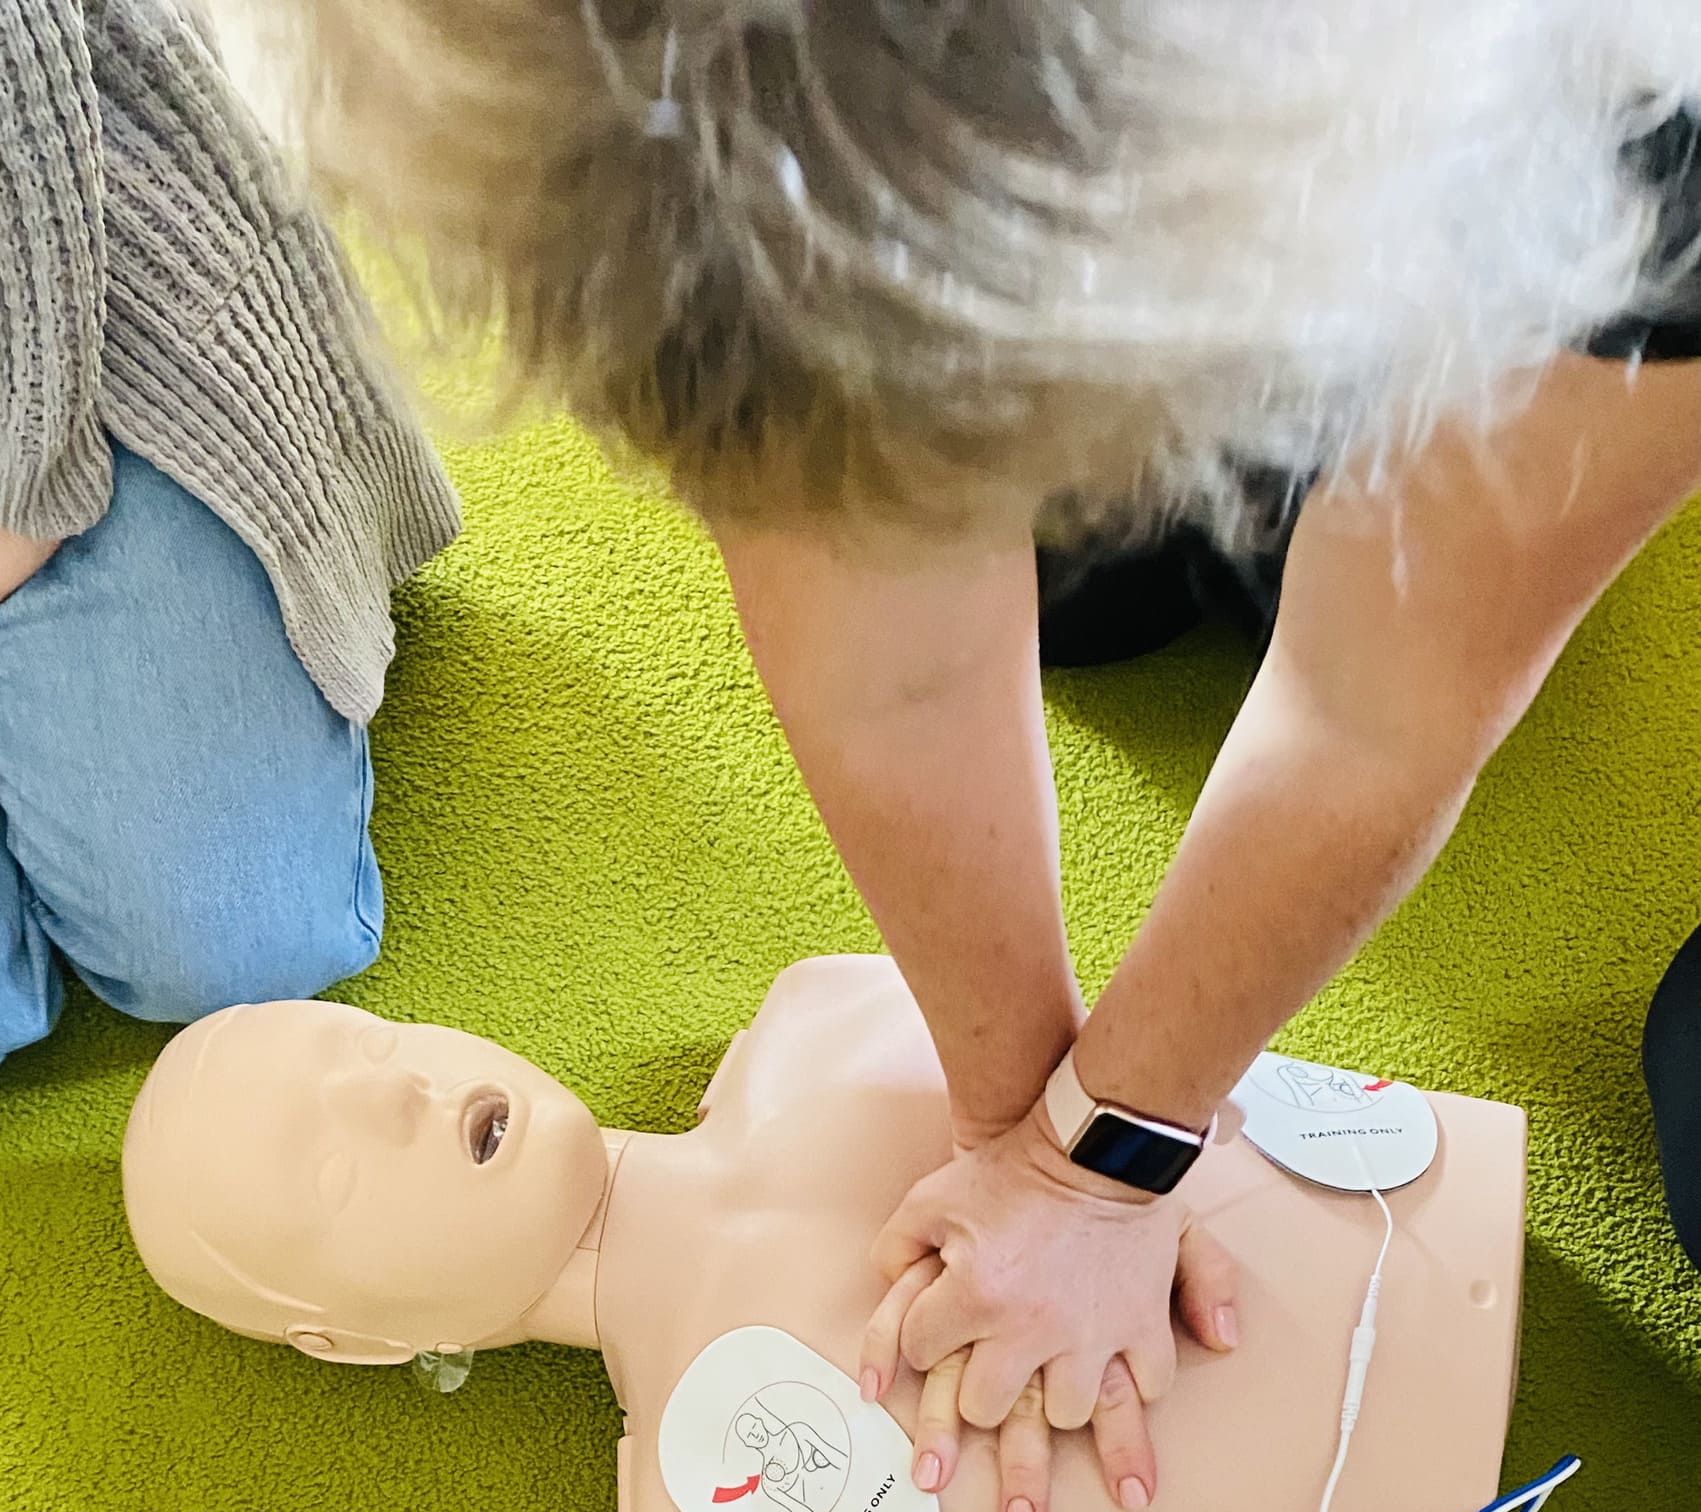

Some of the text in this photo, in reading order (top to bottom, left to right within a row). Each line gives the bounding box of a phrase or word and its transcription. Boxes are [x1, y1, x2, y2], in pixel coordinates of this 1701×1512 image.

[1299, 1127, 1402, 1140] TRAINING ONLY
[870, 1473, 896, 1508] ONLY
